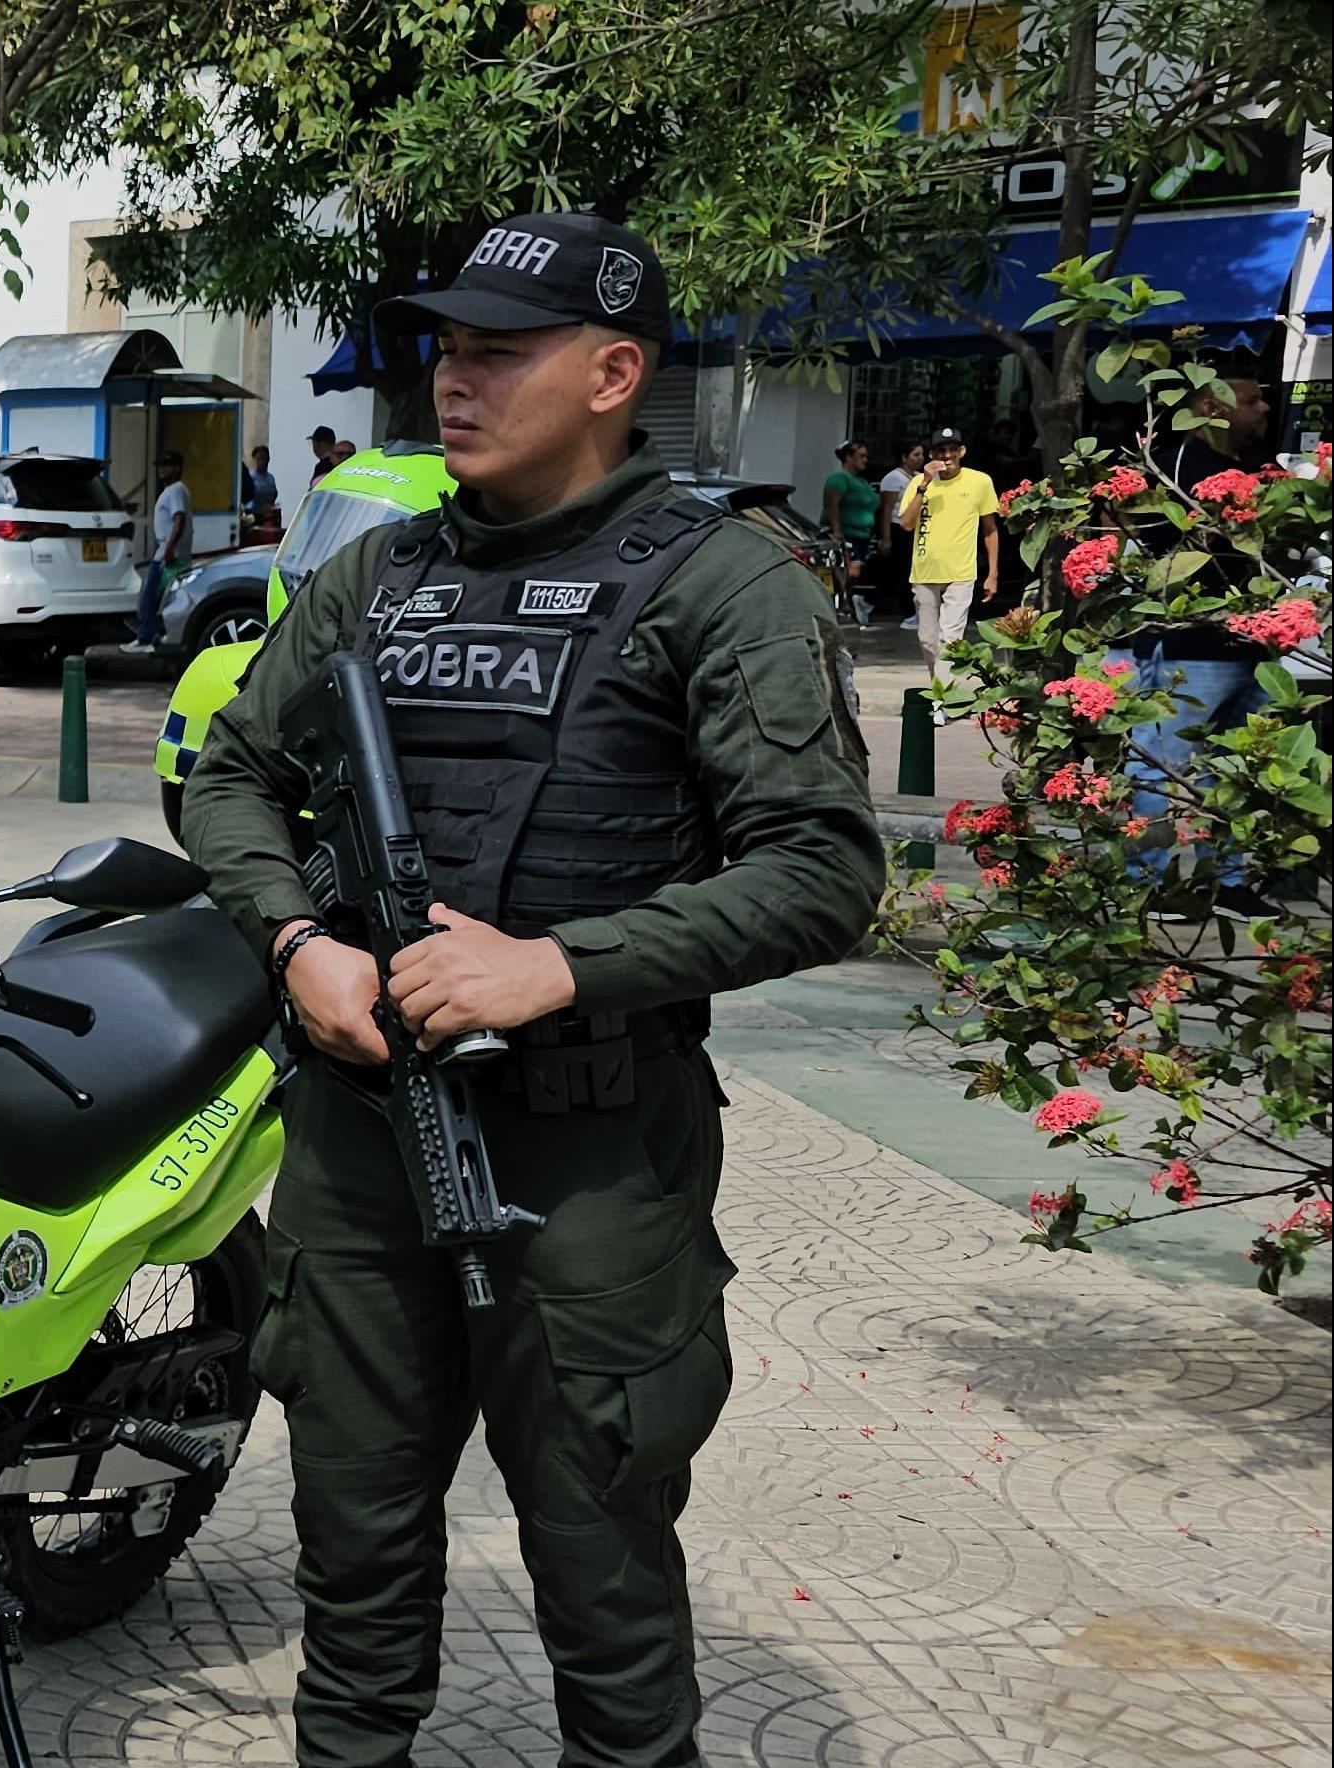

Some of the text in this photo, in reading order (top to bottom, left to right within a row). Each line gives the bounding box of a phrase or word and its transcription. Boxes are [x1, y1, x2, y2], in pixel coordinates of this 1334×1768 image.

[471, 227, 560, 276] BRA
[531, 587, 587, 609] 111504
[376, 643, 543, 694] COBRA
[149, 1095, 239, 1191] 57-3709
